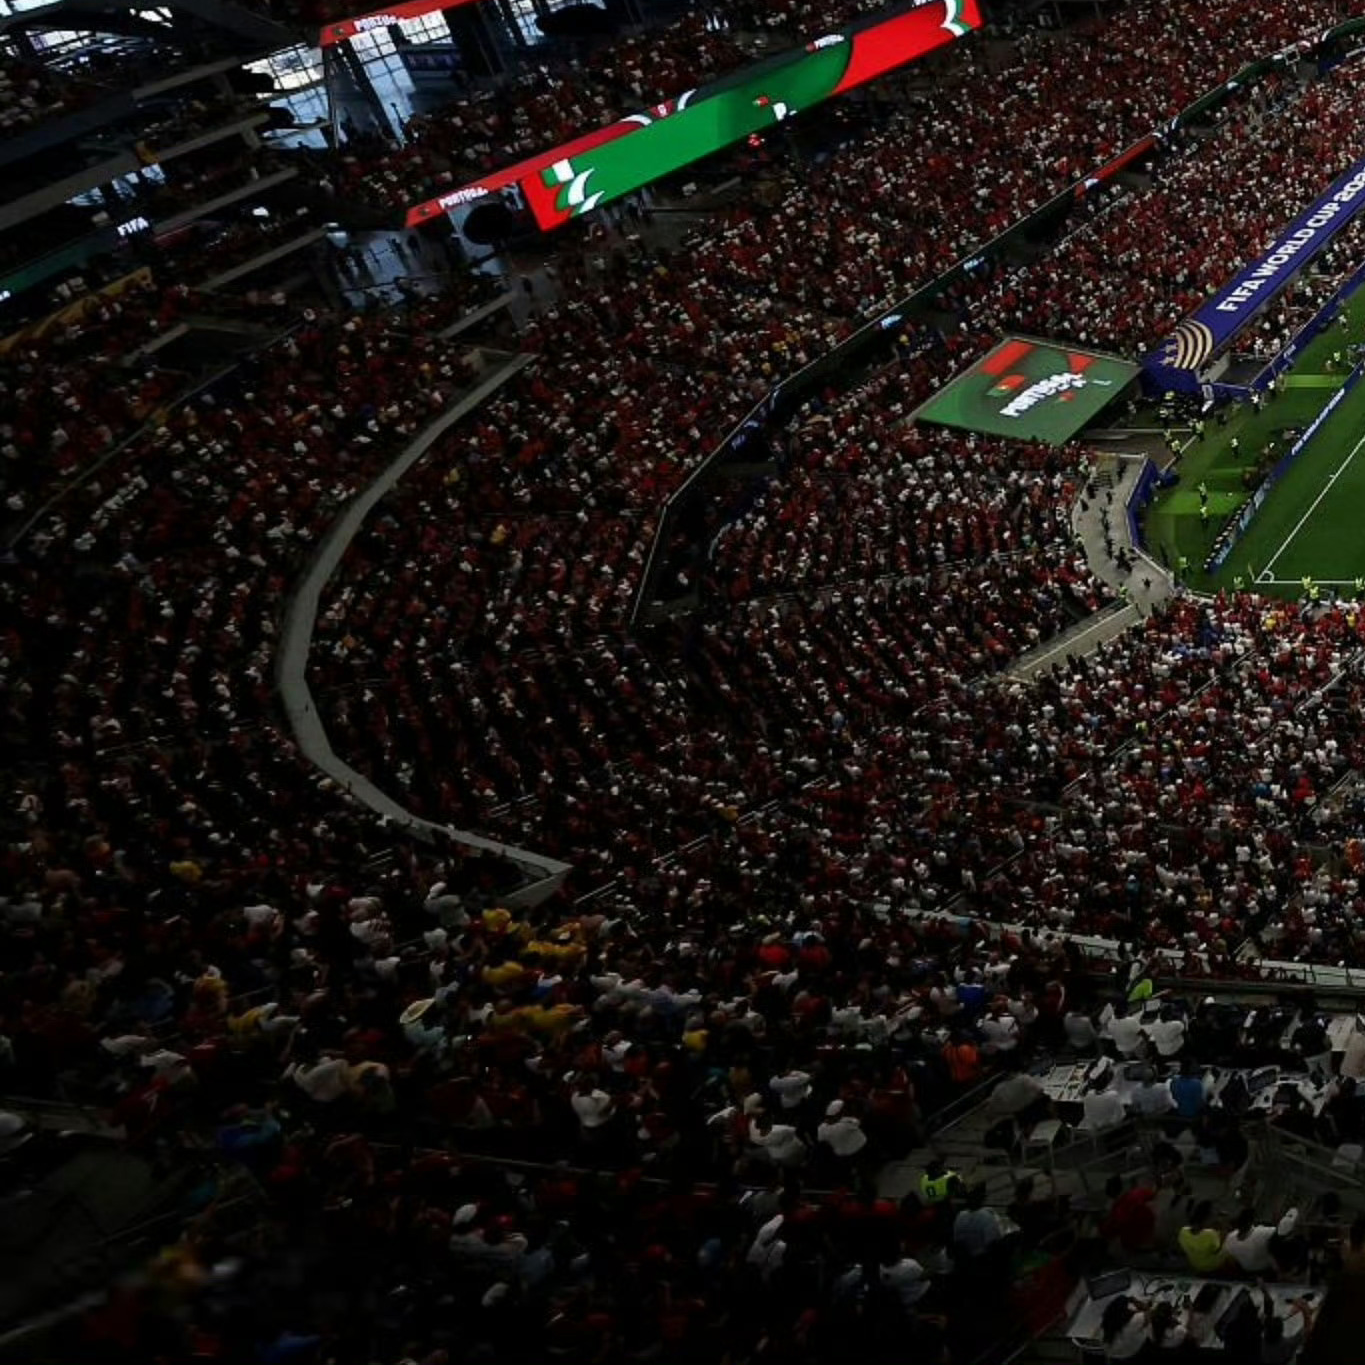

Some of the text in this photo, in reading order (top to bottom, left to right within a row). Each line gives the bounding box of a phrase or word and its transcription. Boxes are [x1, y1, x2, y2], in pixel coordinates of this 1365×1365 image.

[1215, 278, 1267, 312] FIFA
[1251, 228, 1316, 277] WORLD
[1305, 202, 1342, 228] CUP
